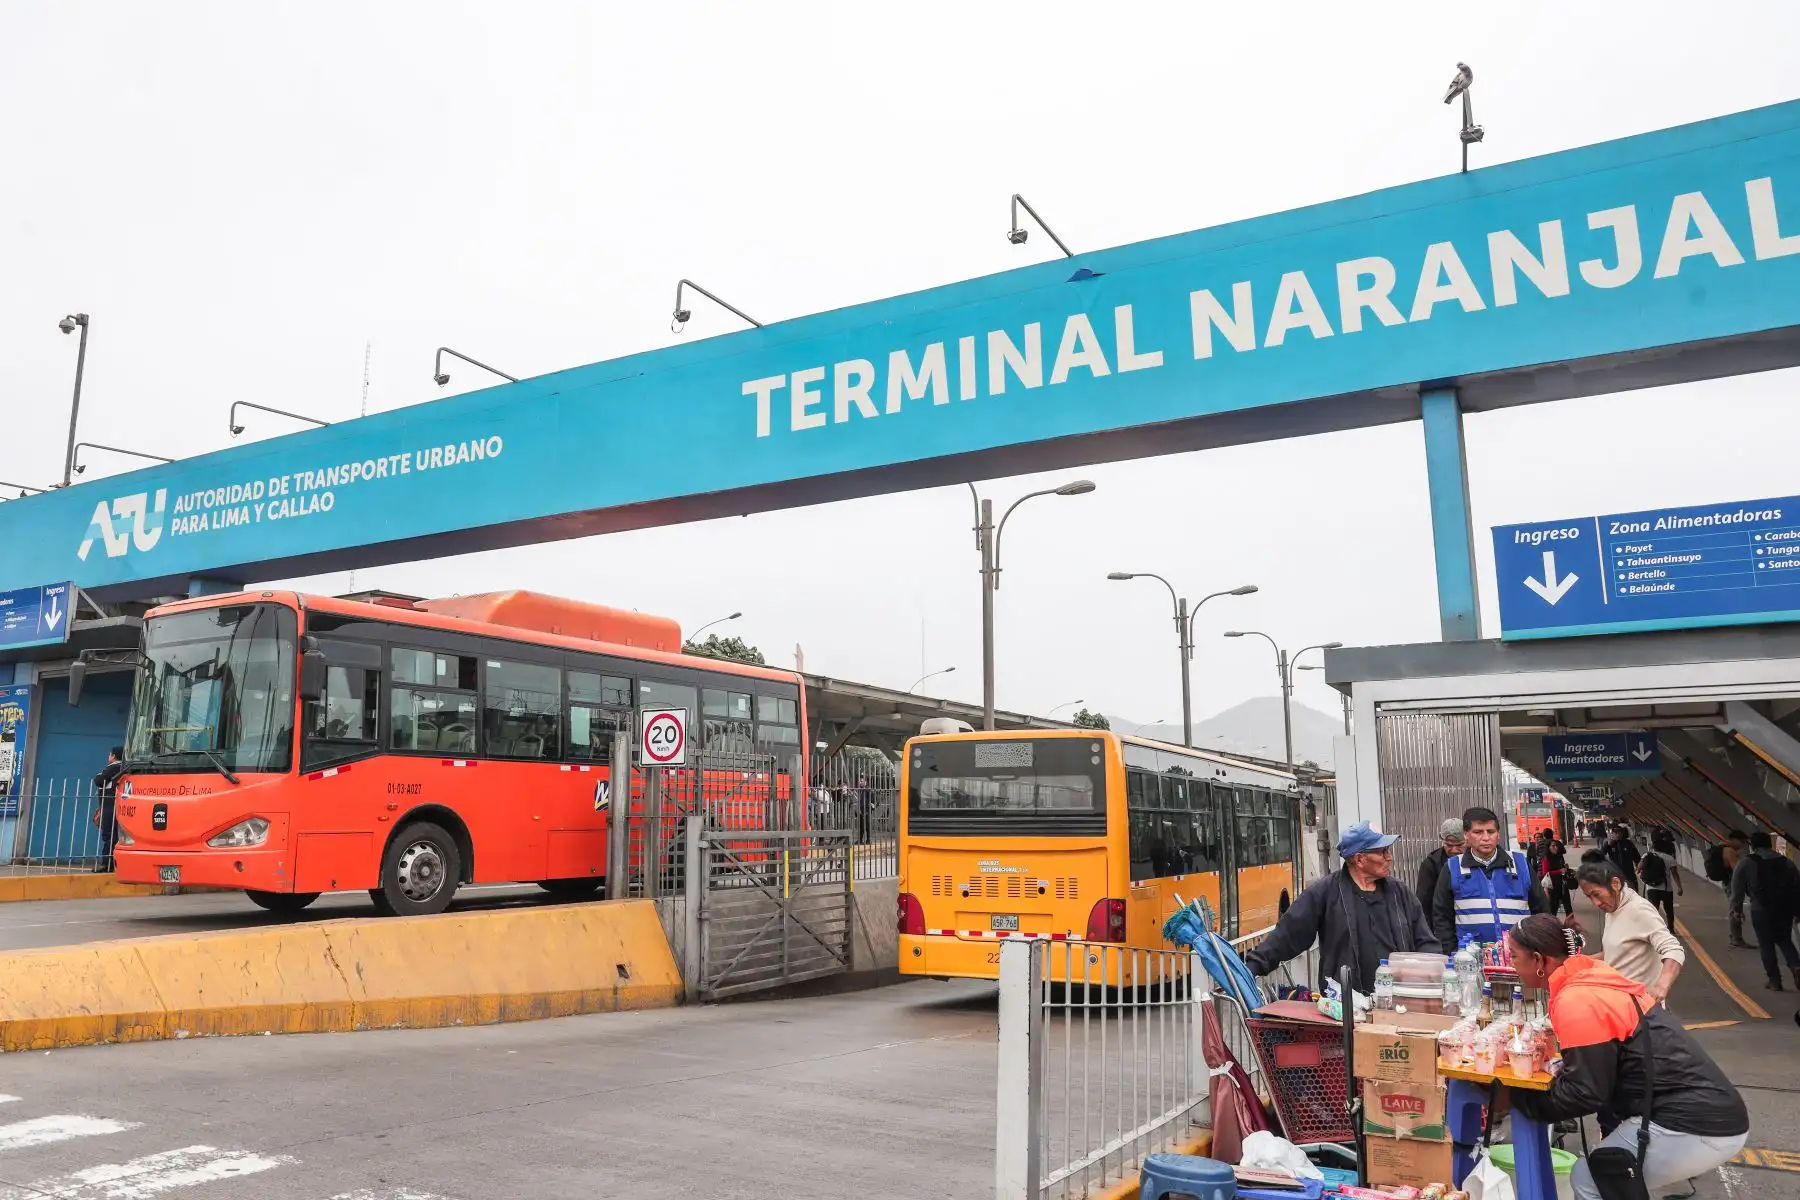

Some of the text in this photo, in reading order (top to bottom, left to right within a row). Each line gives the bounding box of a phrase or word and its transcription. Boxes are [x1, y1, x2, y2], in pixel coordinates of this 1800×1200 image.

[741, 176, 1800, 438] TERMINAL NARANJAL
[173, 436, 503, 514] AUTORIDAD DE TRANSPORTE URBANO
[171, 491, 335, 536] PARA LIMA Y CALLAO
[77, 488, 167, 561] ATU
[1609, 508, 1782, 535] Zona Alimentadoras
[1514, 527, 1580, 546] Ingreso
[1625, 543, 1653, 554] Payet
[1766, 546, 1800, 555] Tunga
[1627, 553, 1702, 567] Tahuantinsuyo
[1768, 560, 1800, 568] Santo
[1628, 570, 1666, 580] Bertello
[1629, 582, 1676, 593] Belaúnde
[651, 725, 677, 744] 20
[1564, 743, 1605, 754] Ingreso
[1546, 753, 1625, 765] Alimentadores
[387, 783, 422, 795] 01-03-A027
[1384, 1098, 1422, 1111] LAIVE
